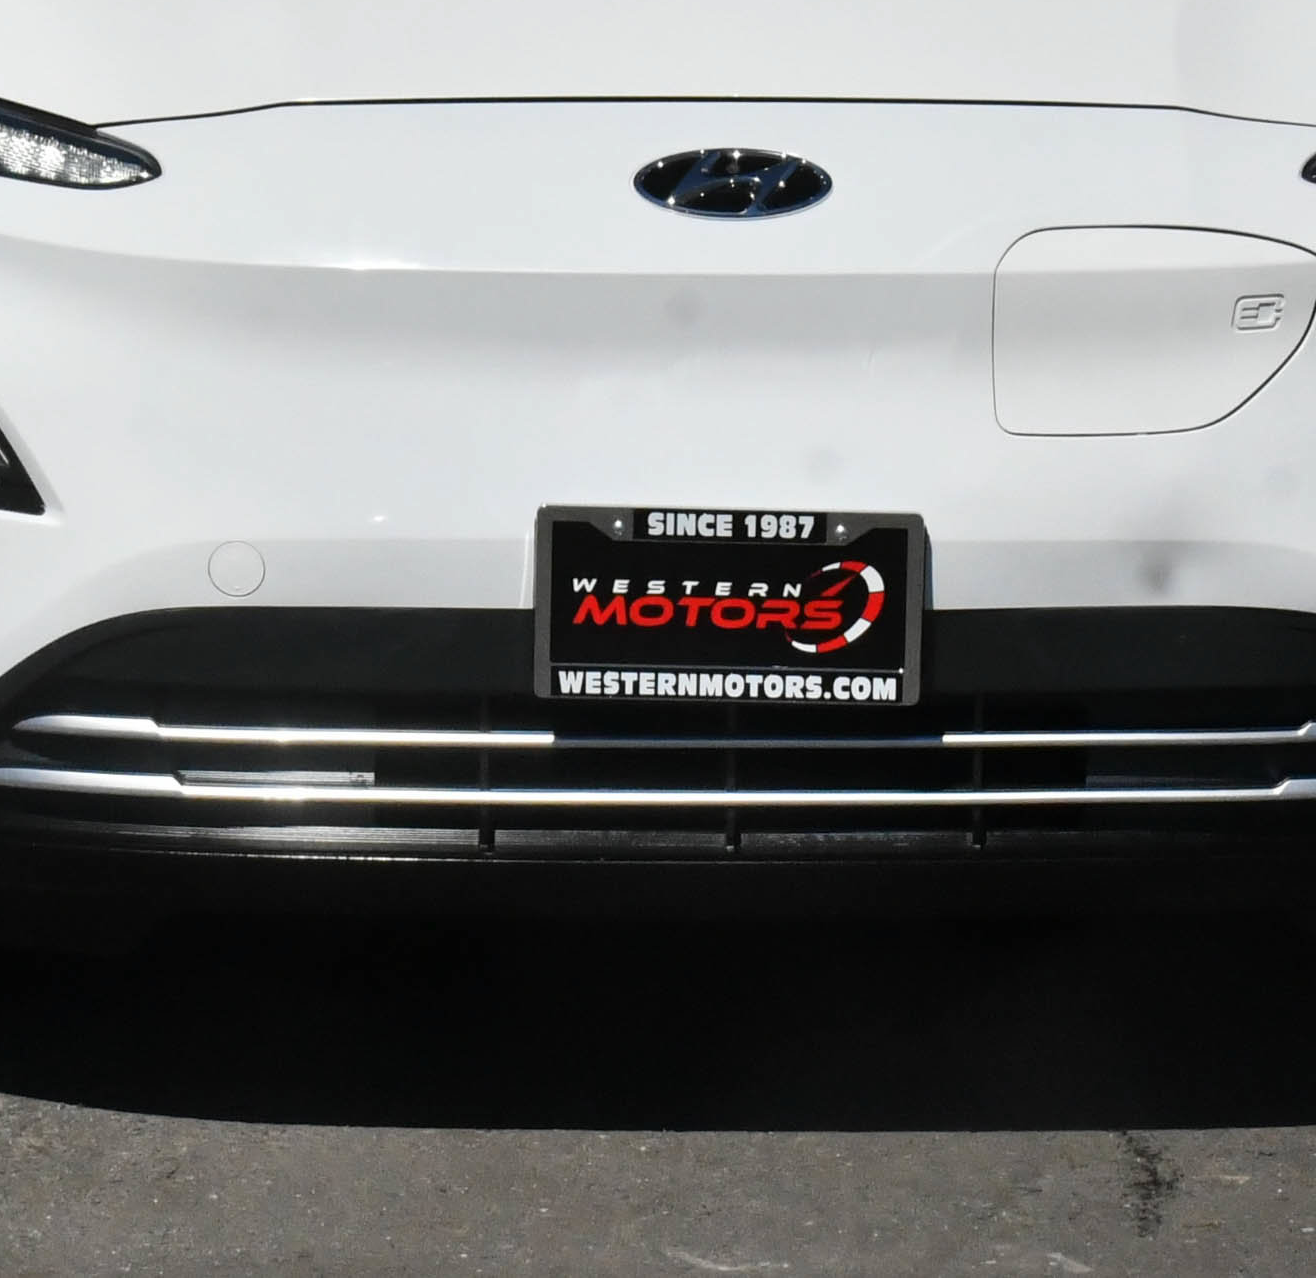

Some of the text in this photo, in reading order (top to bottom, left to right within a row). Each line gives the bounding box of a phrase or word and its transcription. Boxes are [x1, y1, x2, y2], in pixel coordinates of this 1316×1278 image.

[647, 512, 814, 540] SINCE 1987
[572, 578, 802, 598] WESTERN
[572, 595, 844, 631] MOTORS
[559, 670, 897, 702] WESTERNMOTORS.COM
